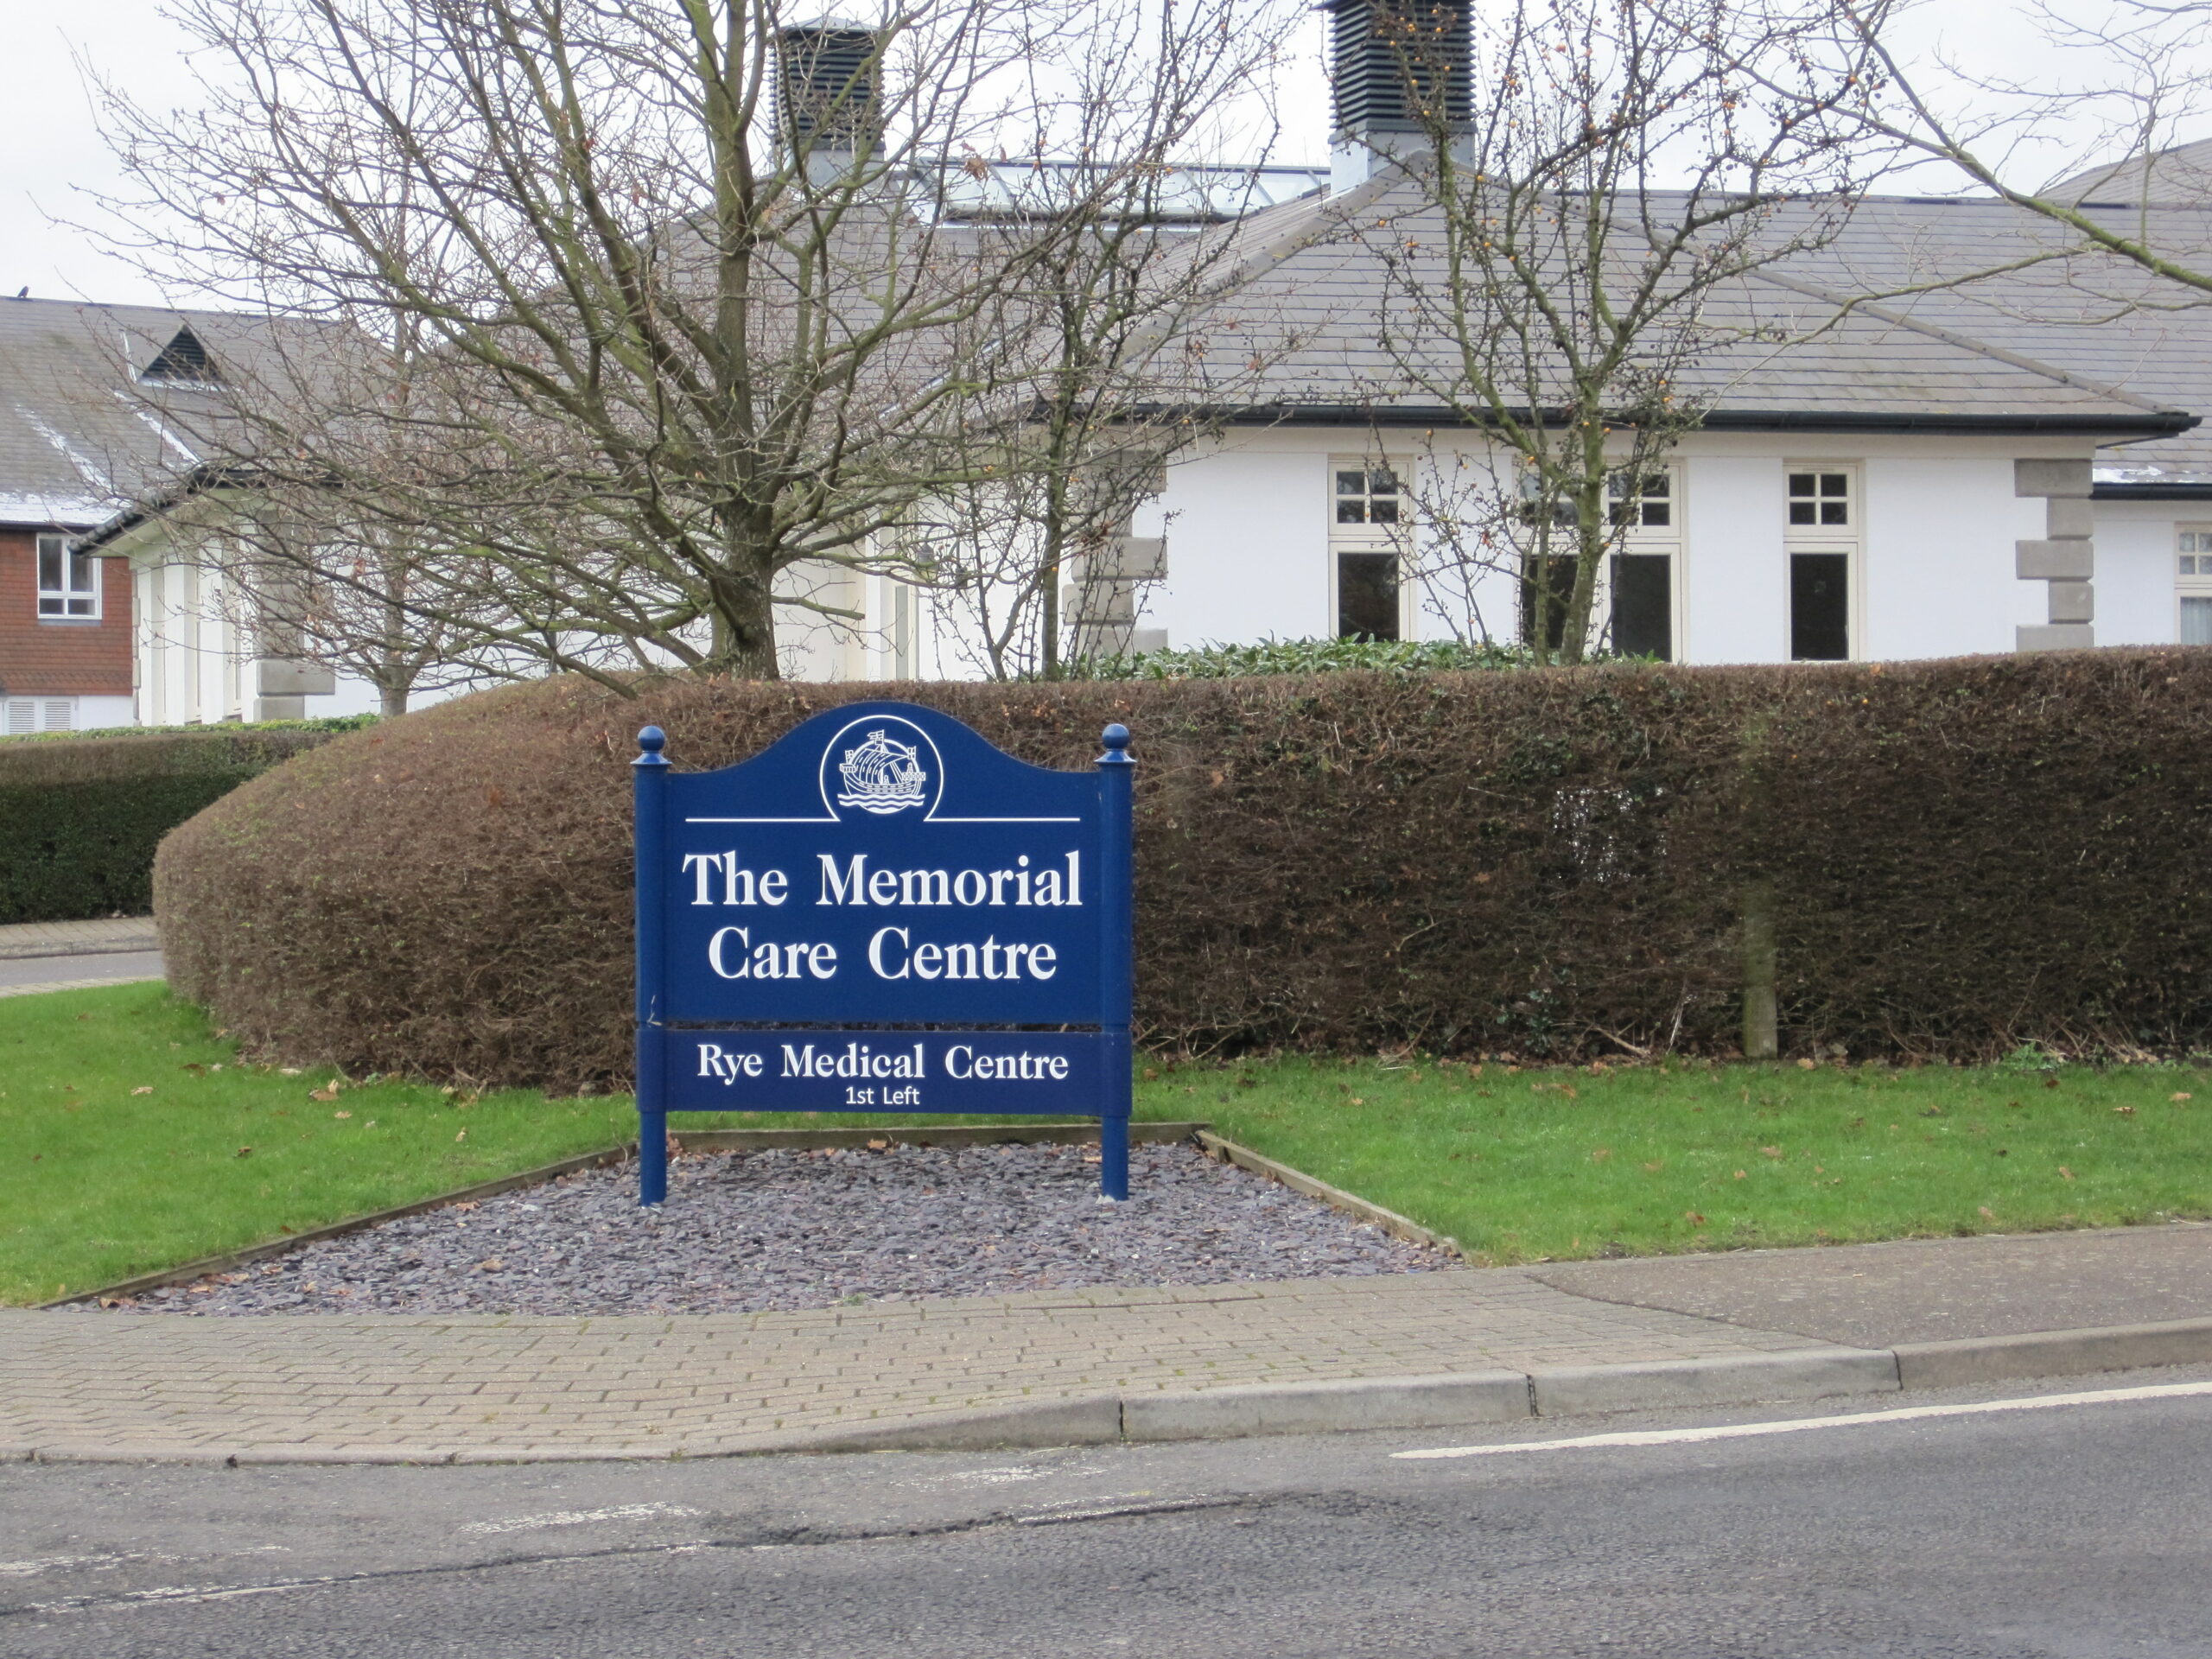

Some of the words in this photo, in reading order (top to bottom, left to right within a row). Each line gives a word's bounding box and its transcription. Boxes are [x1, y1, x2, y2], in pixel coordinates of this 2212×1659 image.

[681, 850, 789, 906] The
[815, 849, 1084, 906] Memorial
[708, 926, 837, 980] Care
[868, 926, 1057, 981] Centre
[696, 1044, 763, 1086] Rye
[780, 1041, 925, 1079] Medical
[944, 1045, 1069, 1080] Centre
[845, 1086, 874, 1105] 1st
[883, 1086, 920, 1105] Left
